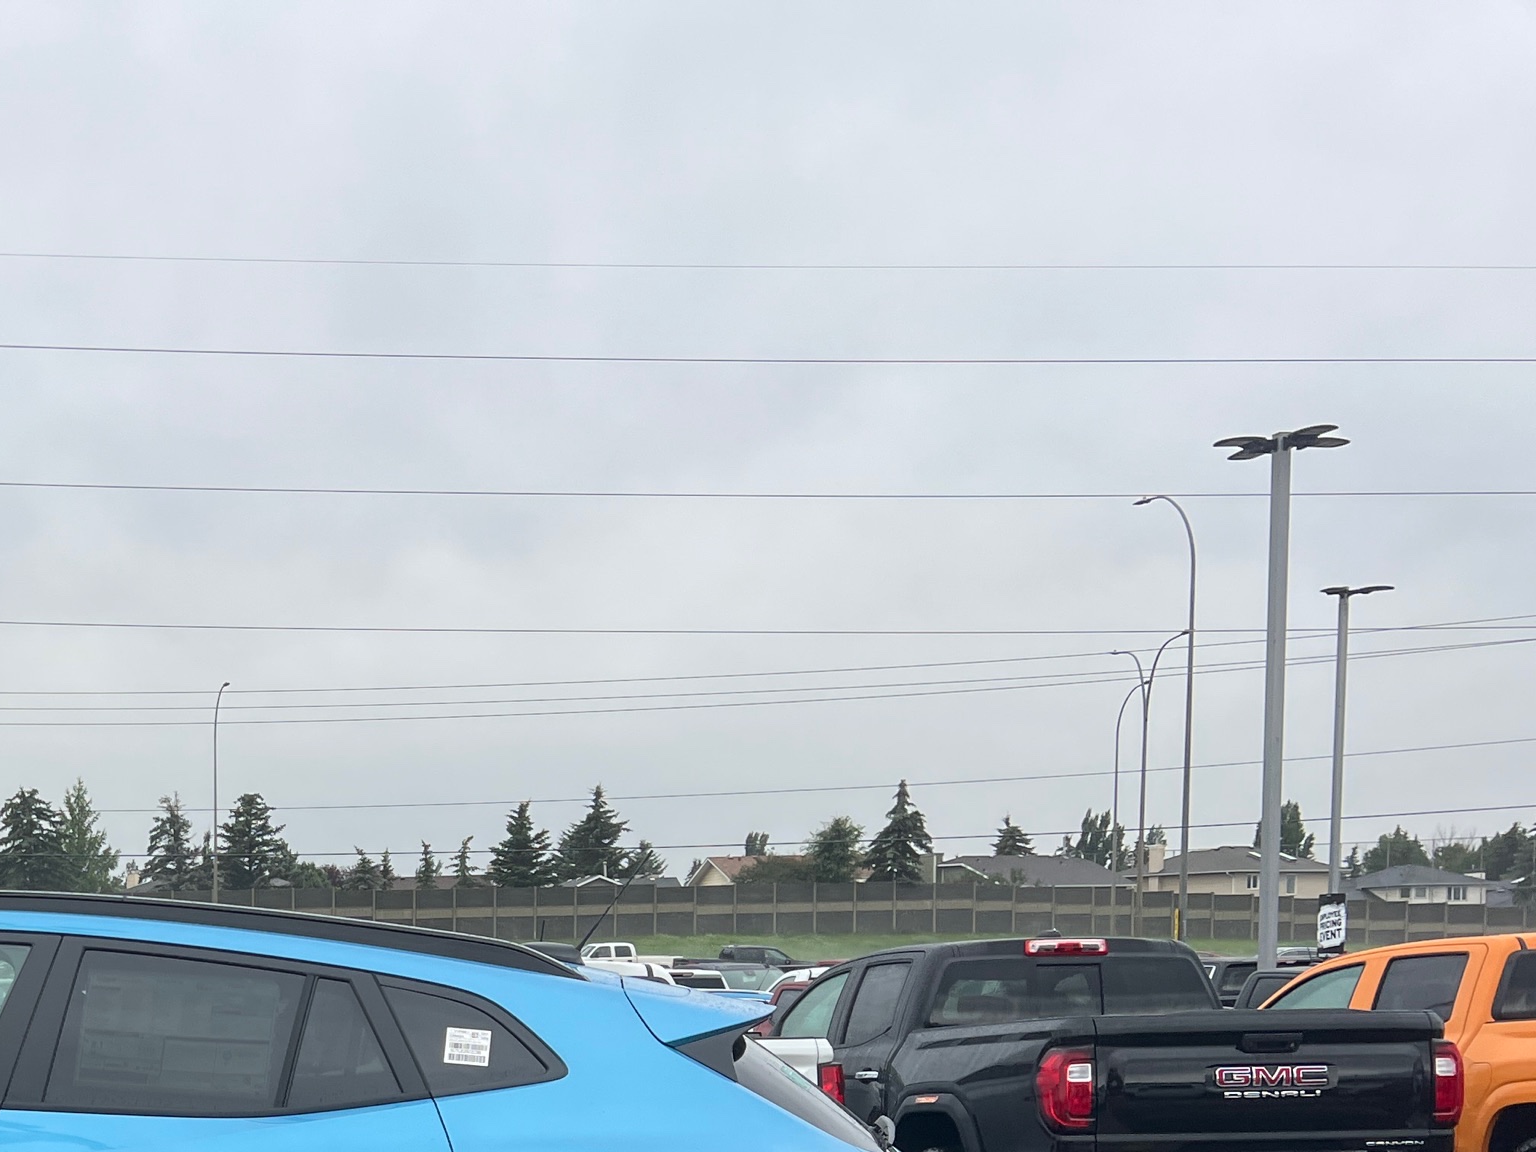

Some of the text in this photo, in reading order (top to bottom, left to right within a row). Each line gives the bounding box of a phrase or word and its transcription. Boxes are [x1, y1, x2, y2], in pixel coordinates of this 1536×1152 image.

[1319, 928, 1342, 942] EVENT
[1215, 1065, 1328, 1088] GMC
[1224, 1090, 1321, 1099] DENALI
